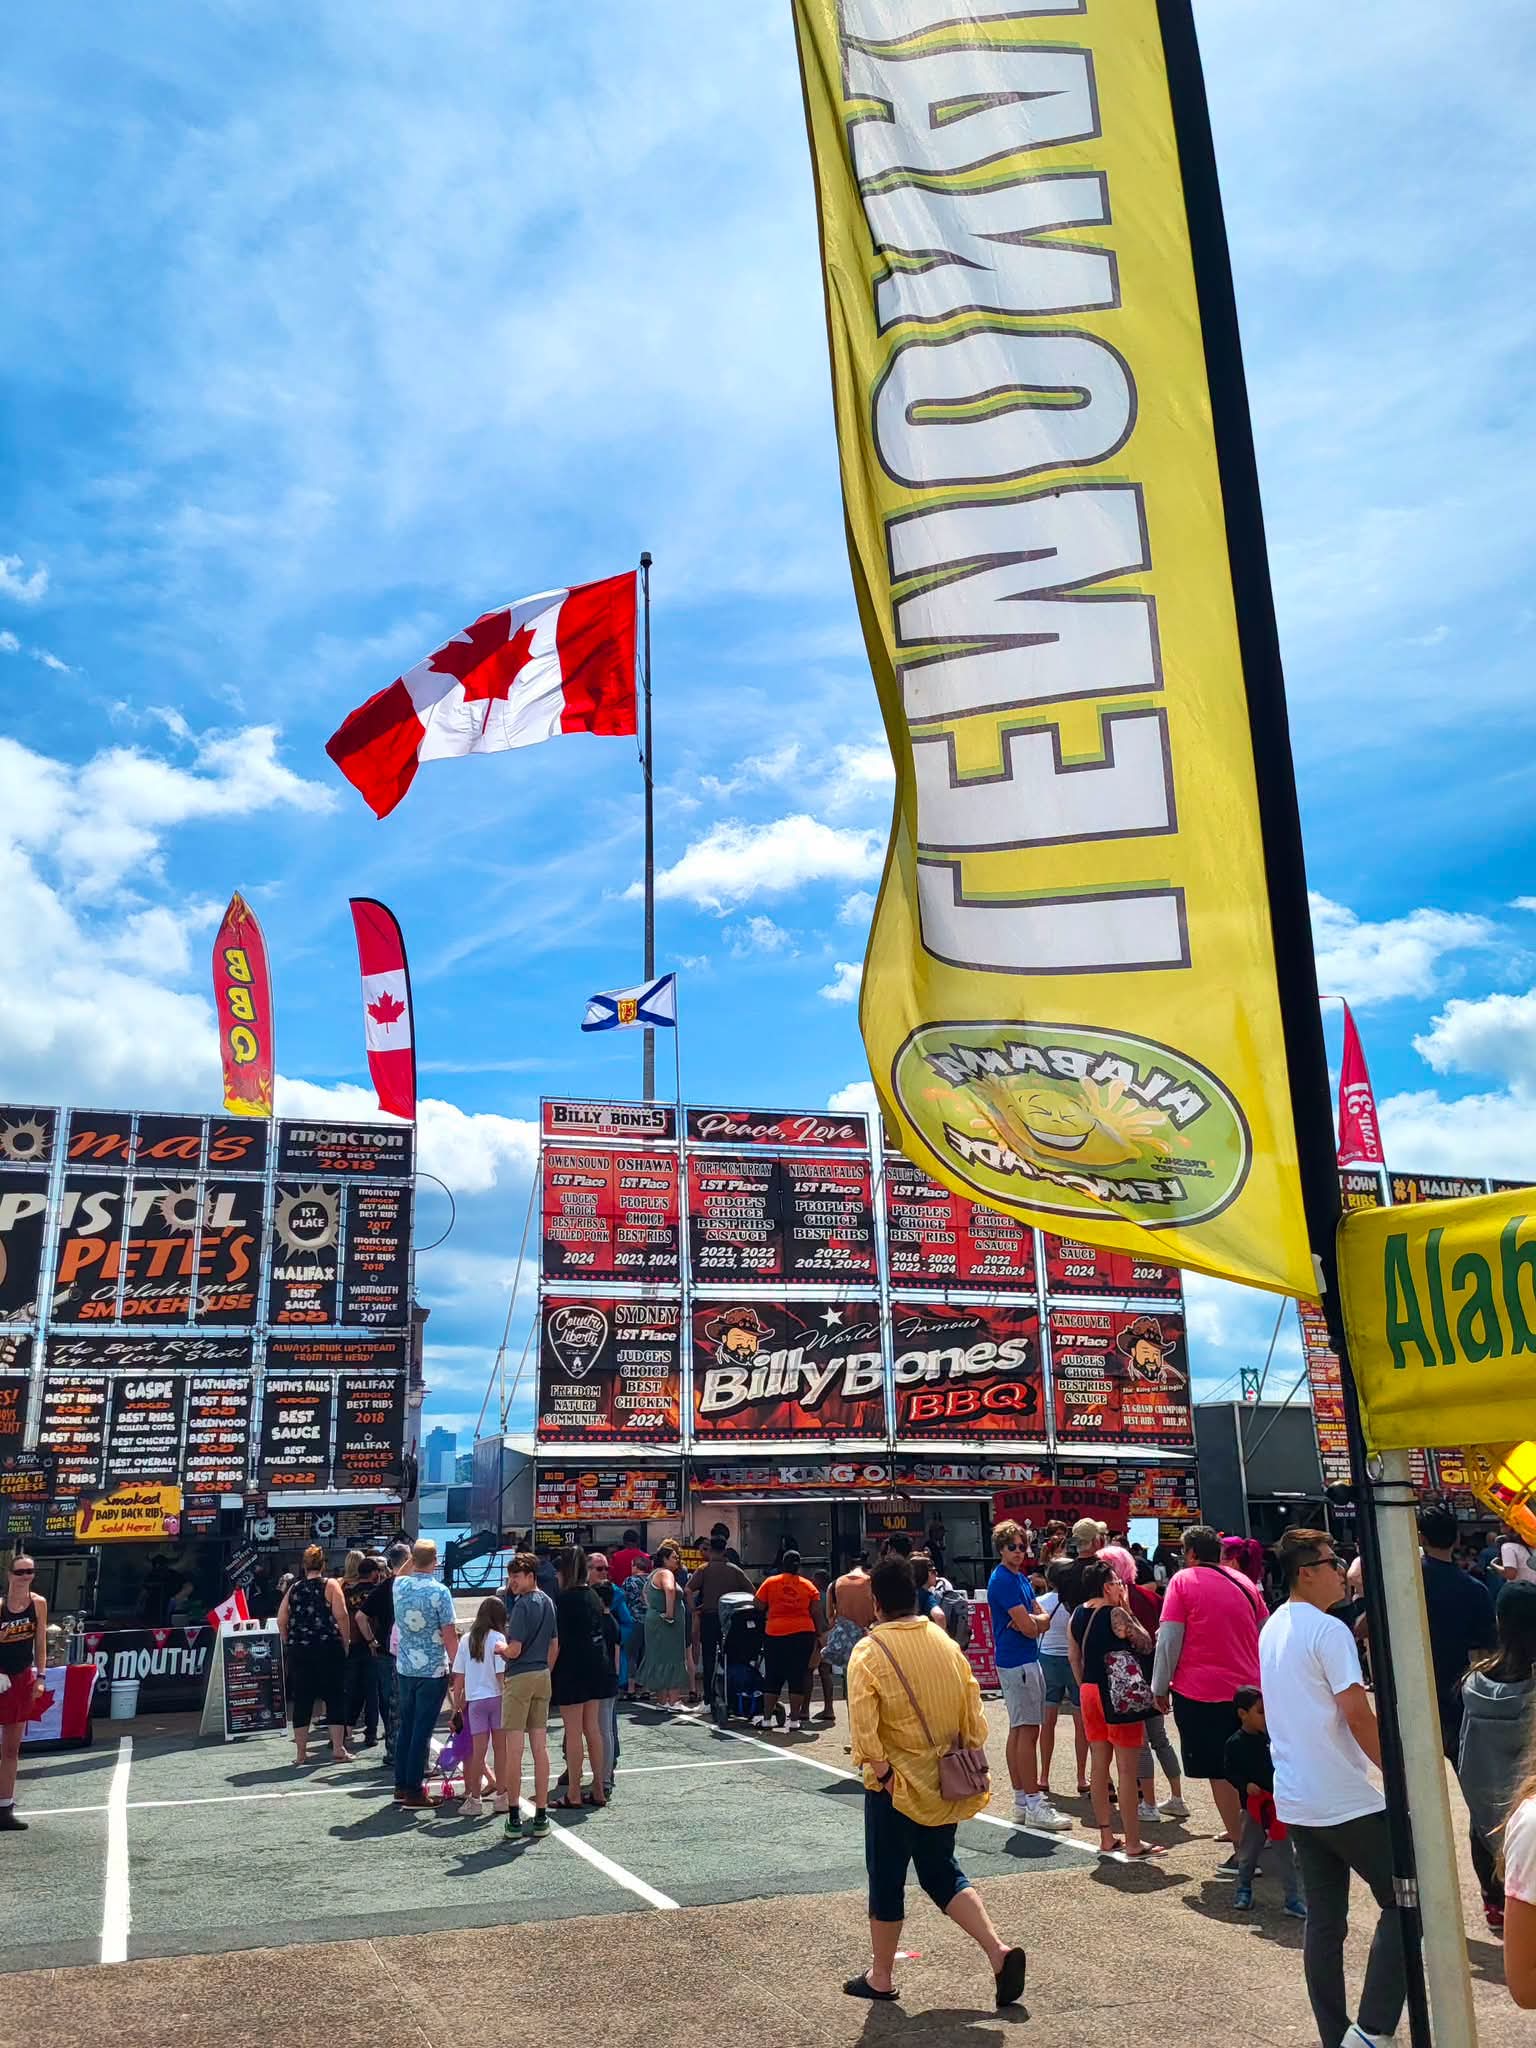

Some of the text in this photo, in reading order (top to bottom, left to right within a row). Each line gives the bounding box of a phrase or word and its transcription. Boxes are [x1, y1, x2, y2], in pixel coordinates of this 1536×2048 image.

[553, 1105, 664, 1127] BILLY BONES
[697, 1113, 856, 1143] Peace, Love
[319, 1159, 376, 1171] 2018
[549, 1155, 610, 1170] OWEN SOUND
[617, 1159, 673, 1172] OSHAWA
[694, 1162, 773, 1176] FORT MCMURRAY
[789, 1164, 864, 1179] NIAGARA FALLS
[887, 1167, 912, 1180] SAULT
[701, 1180, 768, 1192] 1ST Place
[794, 1182, 861, 1194] 1ST Place
[1347, 1175, 1377, 1191] JOHN
[1420, 1179, 1483, 1196] HALIFAX
[893, 1185, 949, 1198] 1ST Place
[620, 1196, 669, 1209] PEOPLE'S
[704, 1197, 765, 1207] JUDGE'S
[796, 1200, 863, 1213] PEOPLE'S
[0, 1189, 247, 1237] PISTOL
[563, 1205, 596, 1216] CHOICE
[708, 1208, 763, 1218] CHOICE
[892, 1205, 950, 1218] PEOPLE'S
[292, 1218, 325, 1228] PLACE
[626, 1212, 664, 1226] CHOICE
[804, 1215, 857, 1226] CHOICE
[900, 1218, 946, 1230] CHOICE
[618, 1229, 672, 1243] BEST RIBS
[794, 1228, 868, 1240] BEST RIBS
[891, 1230, 955, 1243] BEST RIBS
[969, 1228, 1023, 1239] BEST RIBS
[57, 1225, 255, 1283] PETE'S
[563, 1252, 595, 1264] 2024
[814, 1249, 851, 1258] 2022
[1060, 1248, 1095, 1260] SAUCE
[614, 1253, 678, 1267] 2023, 2024
[984, 1255, 1010, 1265] 2022
[273, 1266, 335, 1281] HALIFAX
[1064, 1265, 1095, 1276] 2024
[1132, 1268, 1162, 1279] 2024
[91, 1280, 248, 1301] Oklahoma
[350, 1285, 398, 1294] YARMOUTH
[79, 1293, 254, 1319] SMOKEHOUSE
[615, 1305, 679, 1324] SYDNEY
[1052, 1314, 1110, 1328] VANCOUVER
[616, 1329, 677, 1341] 1ST Place
[795, 1317, 980, 1350] World Famous
[54, 1340, 218, 1355] The Best Ribs
[272, 1344, 310, 1352] ALWAYS
[344, 1343, 396, 1352] UPSTREAM
[54, 1355, 86, 1366] by
[118, 1354, 177, 1364] Long
[185, 1348, 248, 1361] Shot!
[617, 1350, 671, 1362] JUDGE'S
[621, 1365, 669, 1377] CHOICE
[1065, 1368, 1104, 1378] CHOICE
[193, 1378, 249, 1390] BATHURST
[267, 1380, 329, 1392] SMITH'S FALLS
[346, 1379, 395, 1390] HALIFAX
[626, 1381, 661, 1392] BEST
[1058, 1380, 1112, 1392] BEST RIBS
[551, 1385, 601, 1397] FREEDOM
[45, 1393, 104, 1404] BEST RIBS
[191, 1396, 247, 1406] BEST RIBS
[346, 1400, 393, 1409] BEST RIBS
[615, 1396, 672, 1409] CHICKEN
[909, 1382, 1028, 1422] BBQ
[554, 1399, 596, 1411] NATURE
[118, 1412, 175, 1423] BEST RIBS
[279, 1409, 314, 1423] BEST
[354, 1412, 384, 1423] 2018
[544, 1414, 607, 1426] COMMUNITY
[627, 1414, 664, 1427] 2024
[1072, 1414, 1103, 1426] 2018
[40, 1433, 101, 1443] BEST RIBS
[189, 1433, 245, 1443] BEST RIBS
[272, 1426, 320, 1440] SAUCE
[346, 1441, 390, 1449] HALIFAX
[341, 1452, 394, 1460] PEOPLES
[186, 1471, 243, 1482] BEST RIBS
[352, 1475, 382, 1484] 2018
[709, 1467, 769, 1484] THE
[779, 1466, 855, 1483] KING
[863, 1464, 908, 1481] OF
[914, 1464, 1040, 1481] SLINGIN'
[0, 1482, 47, 1493] CHEESE
[102, 1492, 161, 1506] Smoked
[96, 1506, 164, 1520] BABY BACK RIBS
[100, 1522, 156, 1533] Sold Here!
[113, 1647, 207, 1679] MOUTH!
